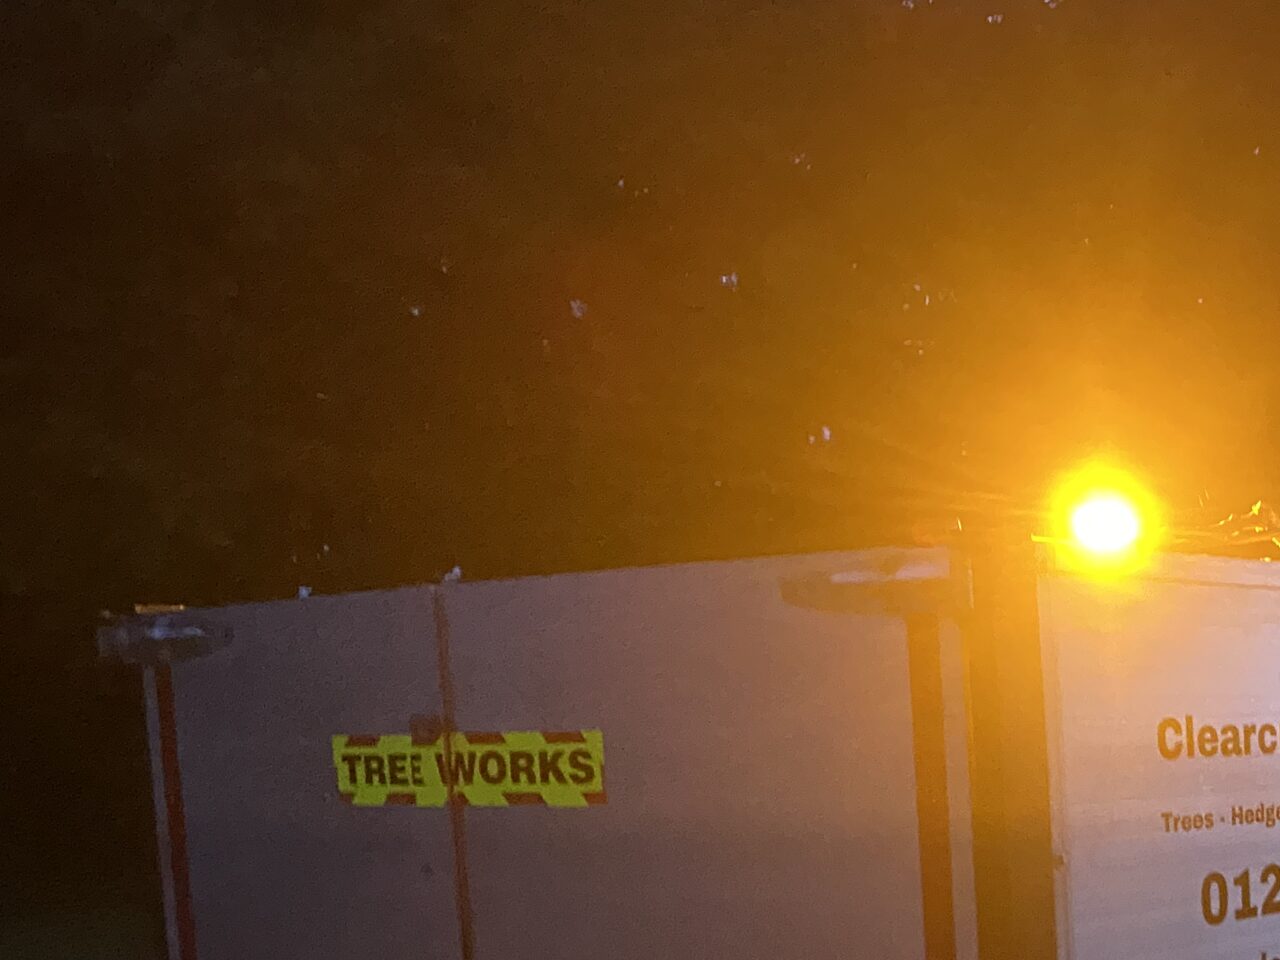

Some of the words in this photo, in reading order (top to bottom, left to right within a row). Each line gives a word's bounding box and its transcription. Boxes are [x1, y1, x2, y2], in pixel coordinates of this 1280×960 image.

[341, 753, 424, 785] TREE
[435, 750, 595, 785] WORKS
[1161, 810, 1214, 833] Trees
